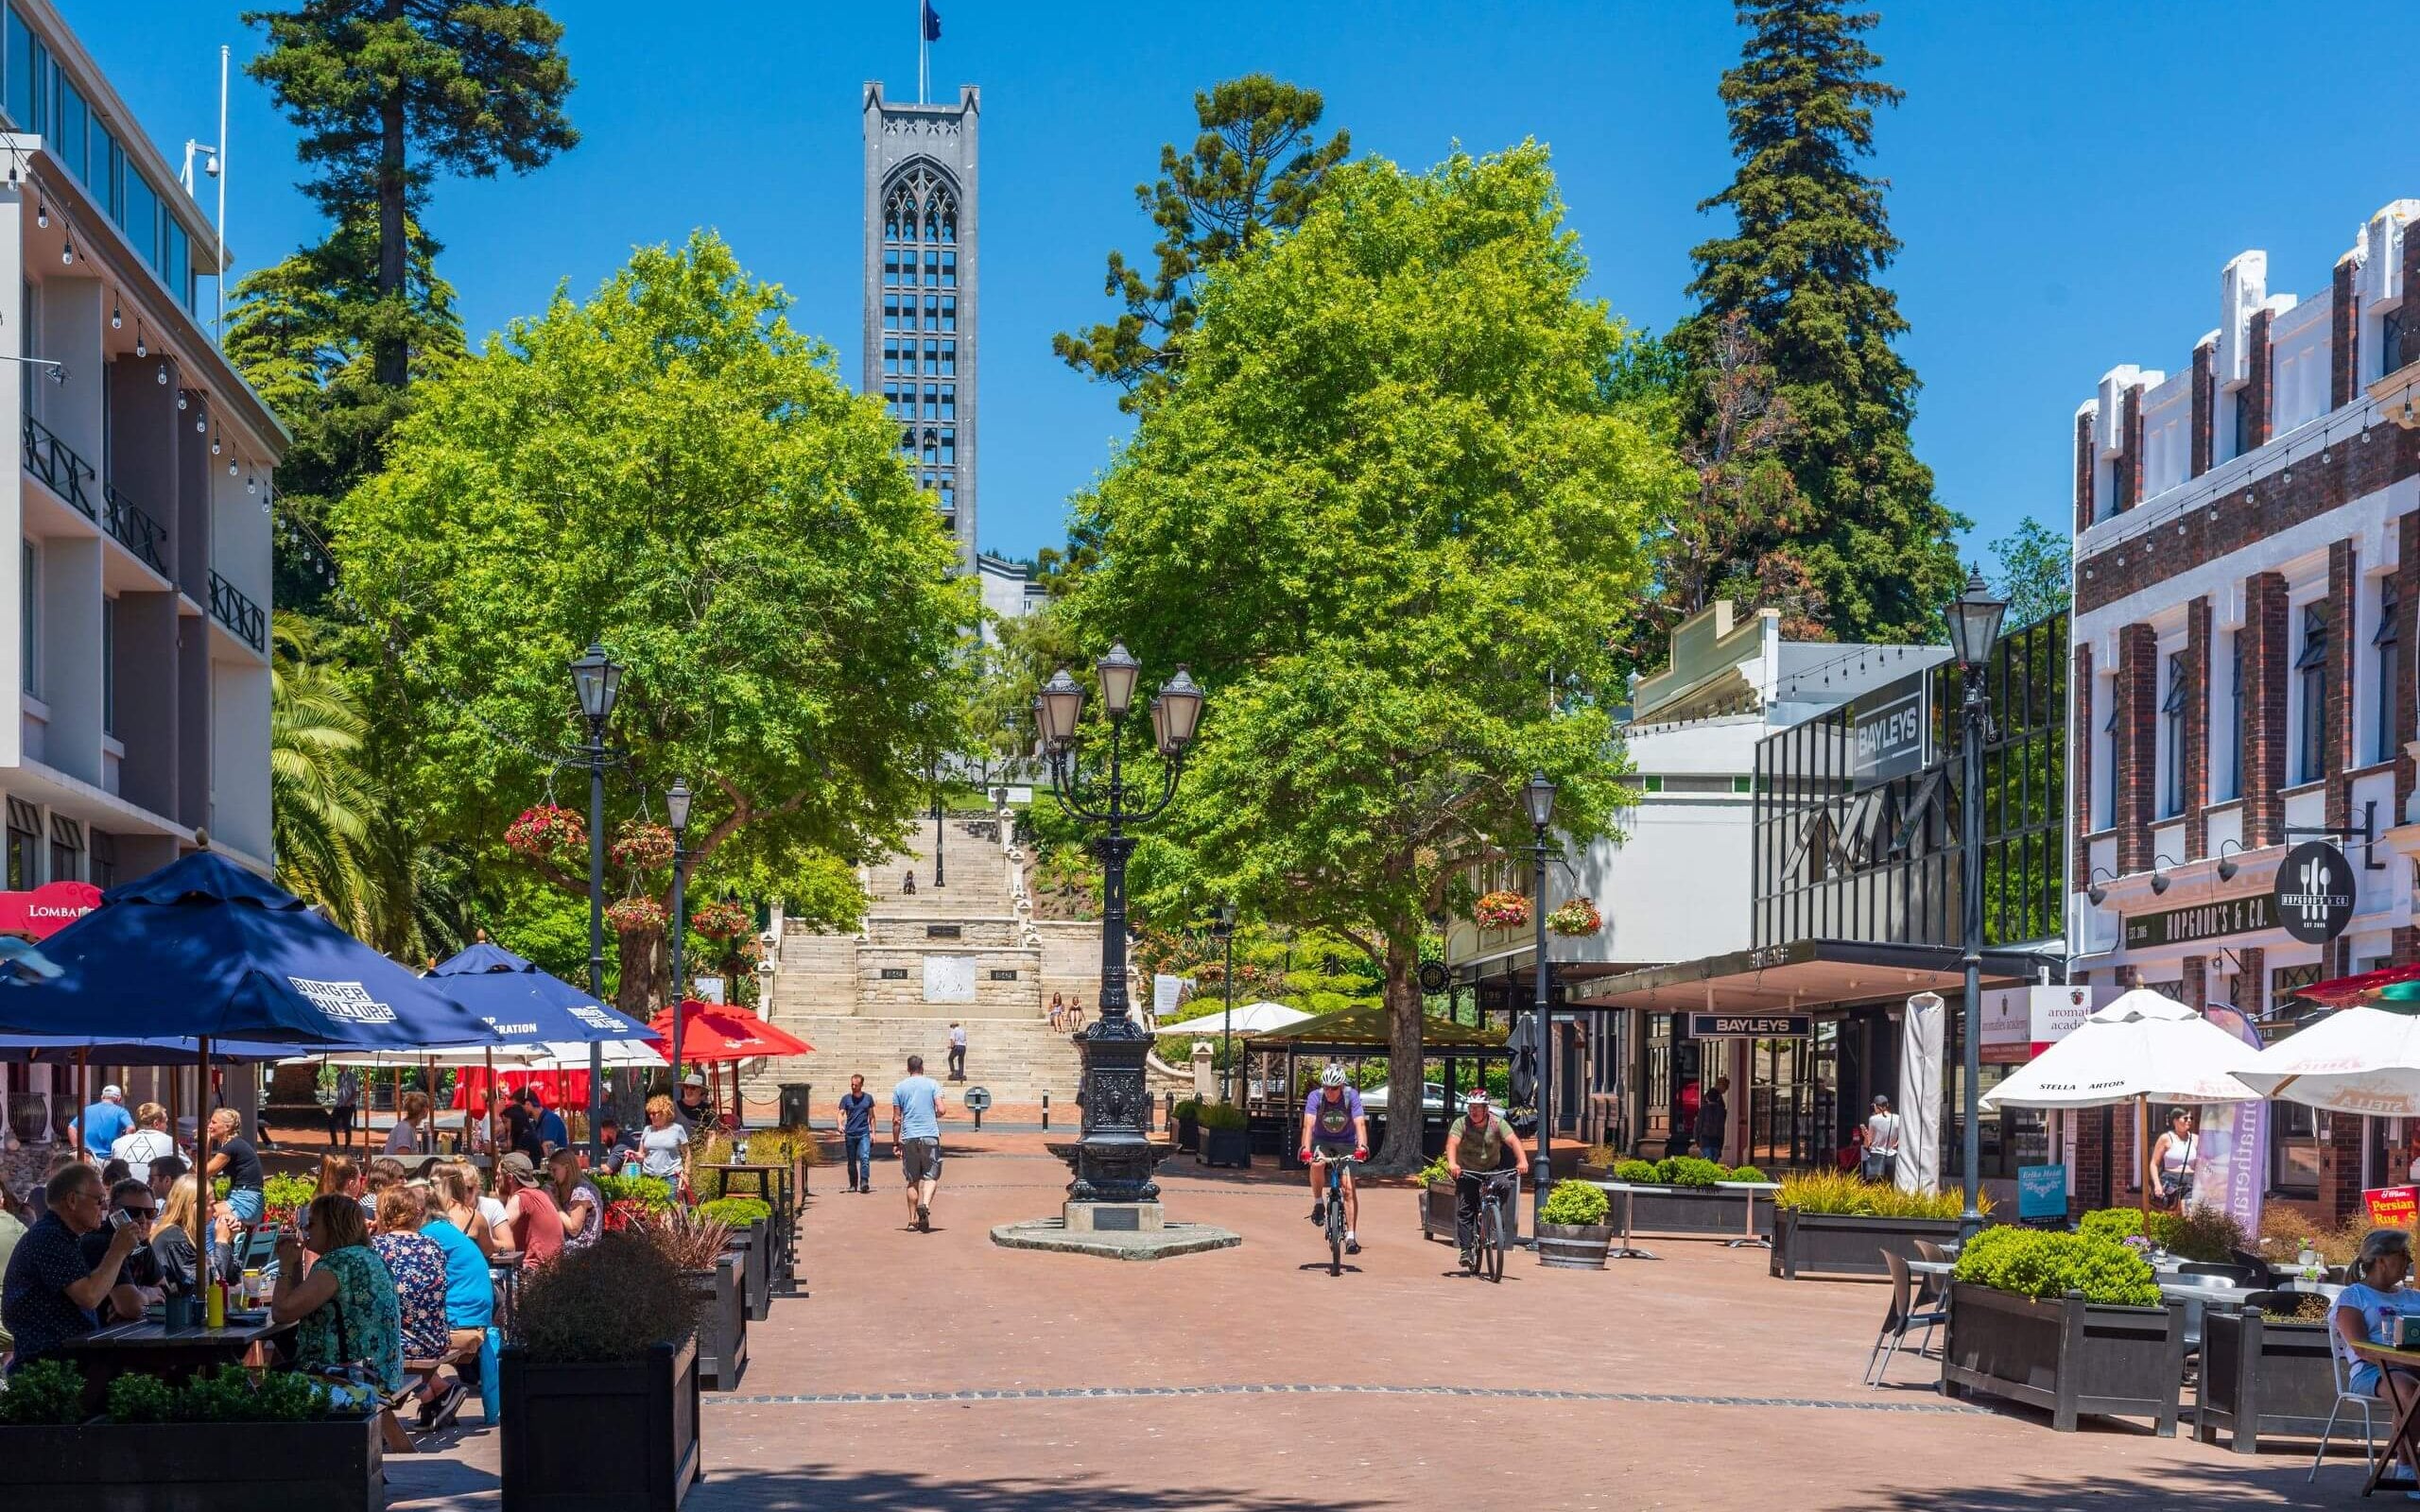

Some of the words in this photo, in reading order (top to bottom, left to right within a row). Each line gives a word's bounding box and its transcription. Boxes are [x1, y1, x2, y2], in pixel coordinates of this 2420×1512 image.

[1858, 707, 1916, 757] BAYLEYS
[2167, 905, 2228, 940] HOPGOOD'S
[2235, 902, 2241, 930] &
[2249, 899, 2268, 928] CO.
[287, 977, 372, 1002] BURGER
[309, 996, 395, 1020] CULTURE
[1716, 1020, 1790, 1032] BAYLEYS
[2088, 1080, 2125, 1090] ARTOIS
[2372, 1199, 2415, 1211] Persian
[2374, 1212, 2398, 1227] Rug
